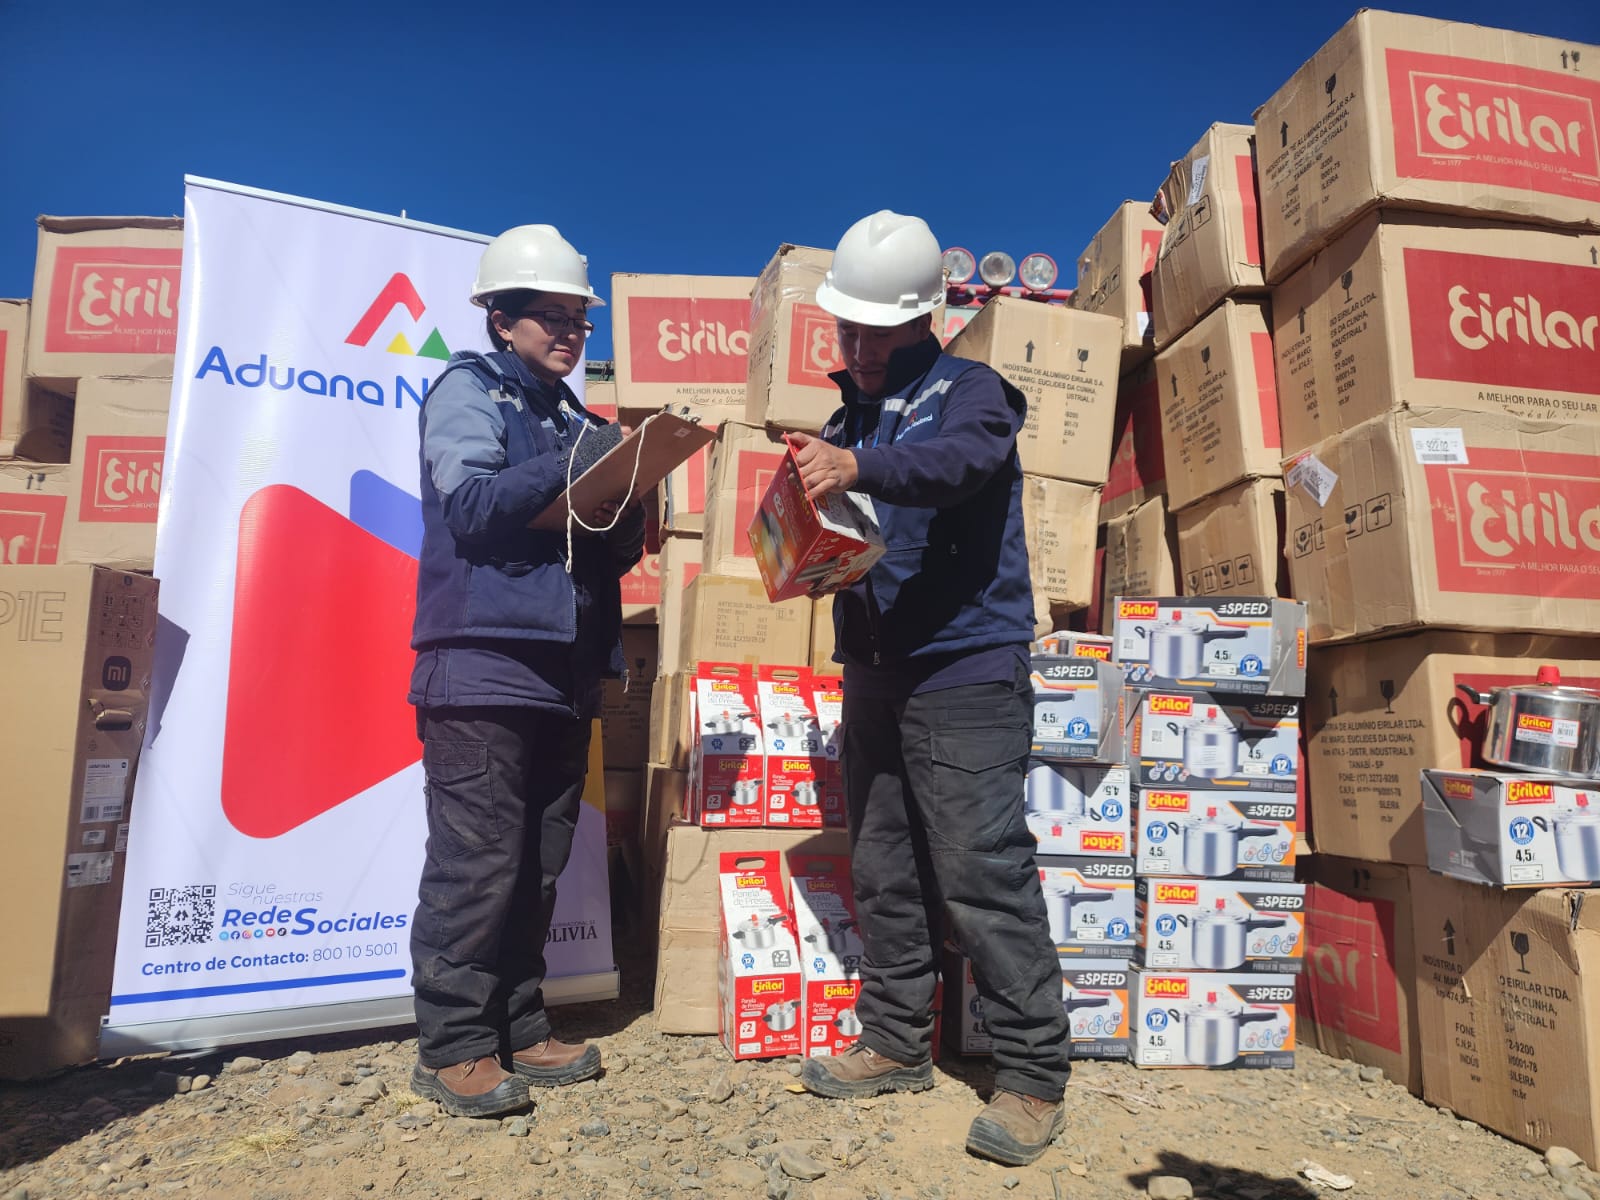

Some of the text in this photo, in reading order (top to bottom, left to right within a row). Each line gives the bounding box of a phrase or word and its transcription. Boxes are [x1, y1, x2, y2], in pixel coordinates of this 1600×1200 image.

[1425, 84, 1581, 158] Eirilar
[1483, 155, 1514, 165] MELHOR
[1515, 160, 1533, 169] PARA
[1541, 163, 1553, 172] SEU
[1448, 285, 1599, 351] Eirilar
[195, 346, 384, 407] Aduana
[1477, 391, 1485, 401] A
[1486, 392, 1526, 405] MELHOR
[1527, 396, 1552, 408] PARA
[1553, 399, 1560, 409] O
[1561, 400, 1579, 410] SEU
[1580, 402, 1598, 413] LAR
[1527, 562, 1559, 572] MELHOR
[1560, 564, 1580, 573] PARA
[1120, 602, 1156, 617] Eirilar
[1226, 603, 1268, 615] SPEED
[1053, 665, 1094, 678] SPEED
[1245, 660, 1258, 672] 12
[1151, 696, 1191, 713] Eirilar
[1260, 703, 1297, 716] SPEED
[1072, 723, 1085, 734] 12
[1377, 720, 1404, 729] EIRILAR
[1520, 715, 1552, 729] Eirilar
[1347, 734, 1378, 744] EUCLIDES
[1378, 733, 1388, 742] DA
[1276, 759, 1287, 771] 12
[1508, 782, 1550, 802] Eirilar
[1148, 792, 1187, 808] Eirilar
[1106, 804, 1118, 817] 12
[1255, 805, 1295, 817] SPEED
[1151, 826, 1163, 837] 12
[1514, 823, 1530, 839] 12
[1083, 834, 1124, 852] Eirilar
[1092, 864, 1133, 877] SPEED
[226, 881, 277, 898] Sigue
[1156, 885, 1197, 900] Eirilar
[252, 890, 323, 906] nuestras
[1264, 896, 1303, 909] SPEED
[1112, 923, 1124, 935] 12
[1160, 919, 1172, 931] 12
[141, 942, 398, 976] Centro de Contacto: 800 10 5001
[1085, 972, 1126, 986] SPEED
[1507, 977, 1543, 994] EIRILAR
[753, 980, 784, 993] Eirilar
[1146, 978, 1187, 995] Eirilar
[1255, 988, 1293, 1000] SPEED
[1521, 996, 1558, 1016] CUNHA,
[1151, 1014, 1163, 1025] 12
